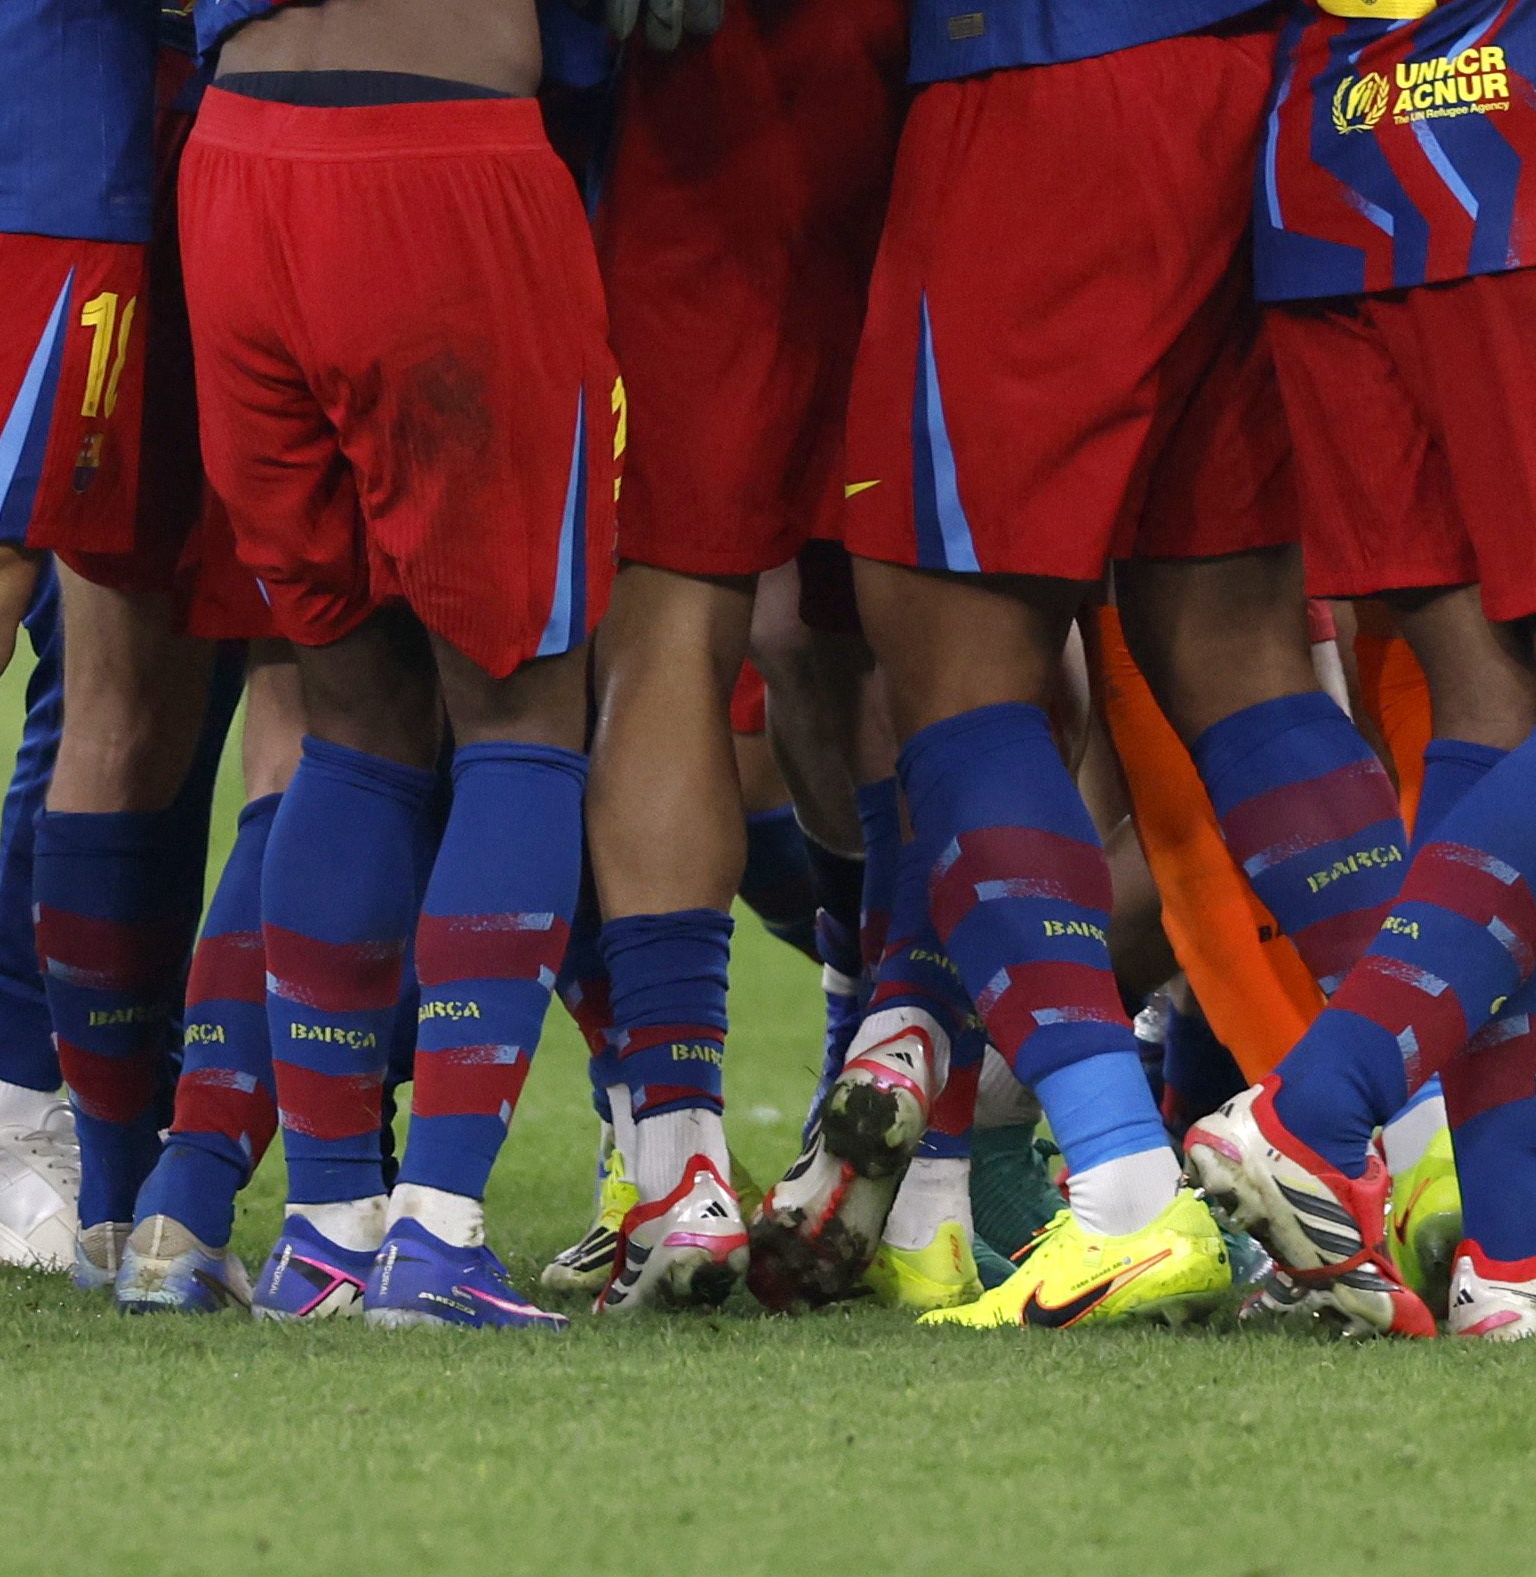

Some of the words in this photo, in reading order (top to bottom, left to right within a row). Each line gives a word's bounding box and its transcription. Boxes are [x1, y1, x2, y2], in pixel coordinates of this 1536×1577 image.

[1395, 46, 1507, 89] UNHCR
[1392, 73, 1510, 115] ACNUR
[1394, 115, 1410, 125] The
[1426, 104, 1469, 120] Refugee
[1469, 101, 1510, 114] Agency
[1306, 844, 1402, 893] BARÇA
[290, 1022, 377, 1050] BARÇA
